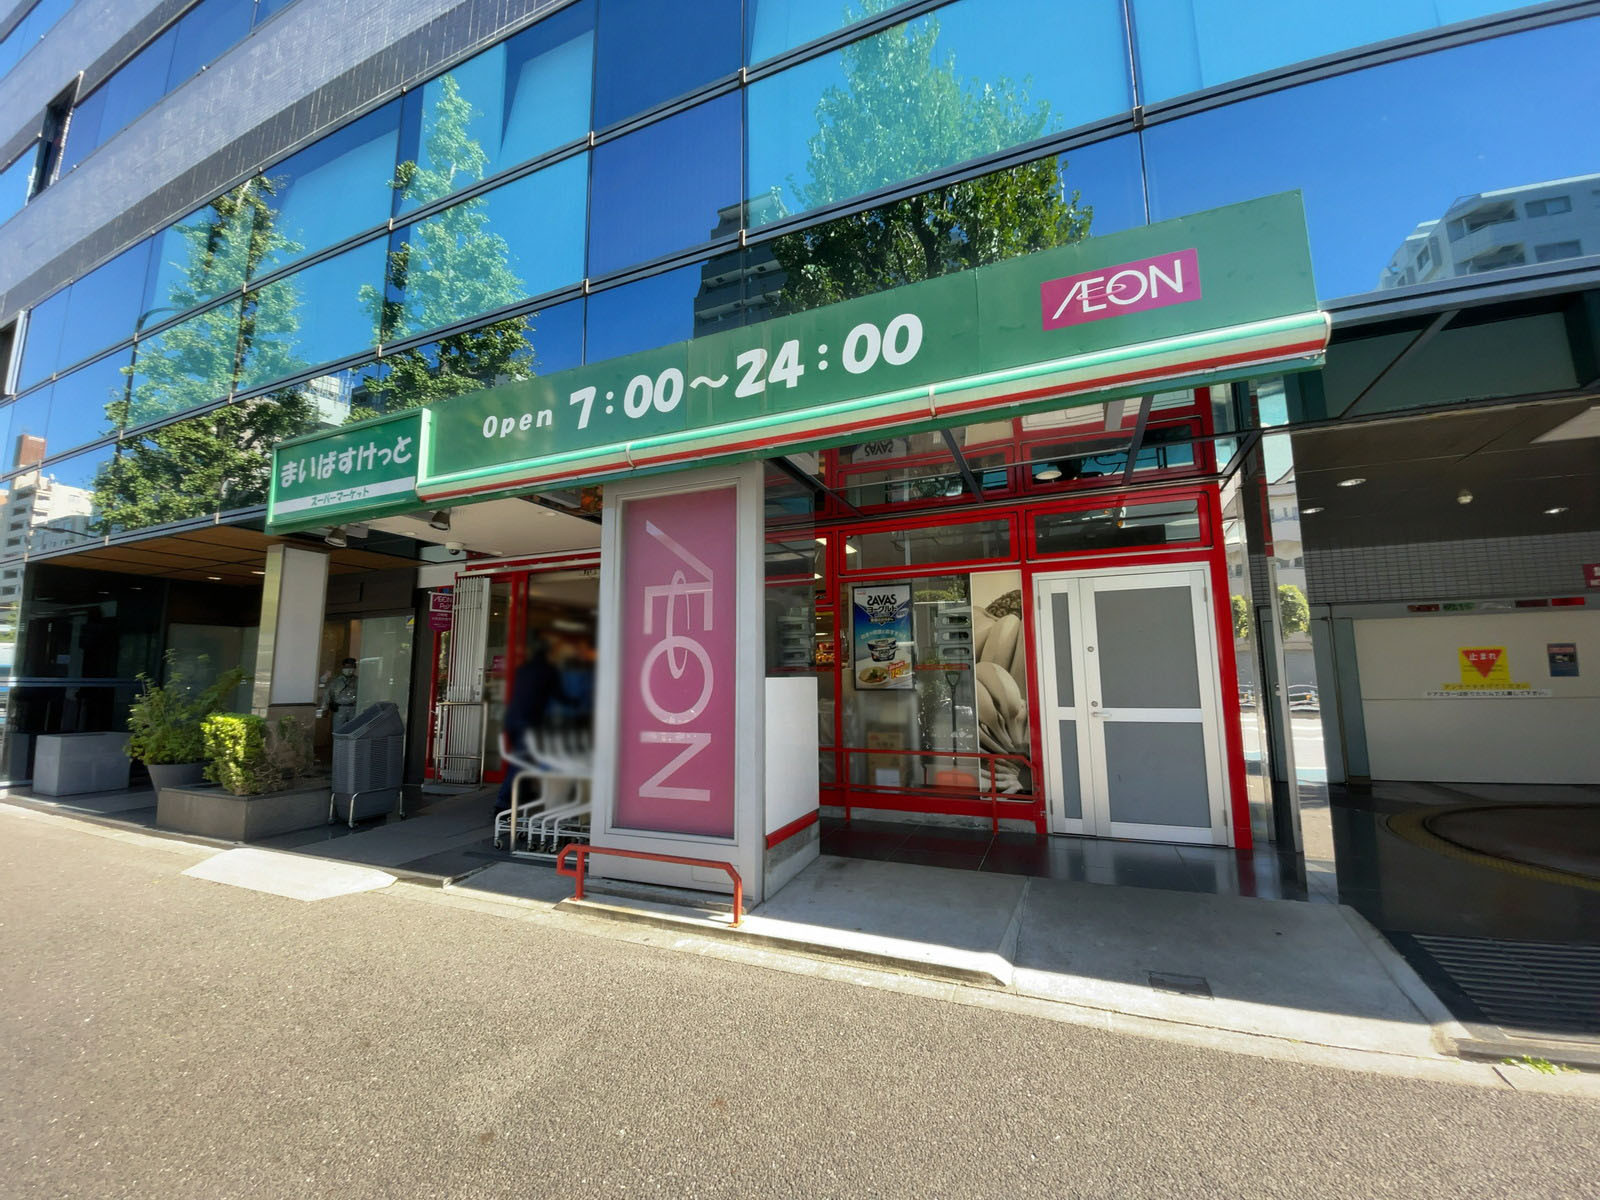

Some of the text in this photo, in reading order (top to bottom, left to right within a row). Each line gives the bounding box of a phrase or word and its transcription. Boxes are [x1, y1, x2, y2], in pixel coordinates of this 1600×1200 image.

[482, 409, 553, 438] Open
[280, 436, 412, 488] まいばすけっと
[311, 487, 369, 506] スーパーマーケット
[867, 594, 897, 606] SAVAS
[1469, 652, 1497, 661] 止まれ
